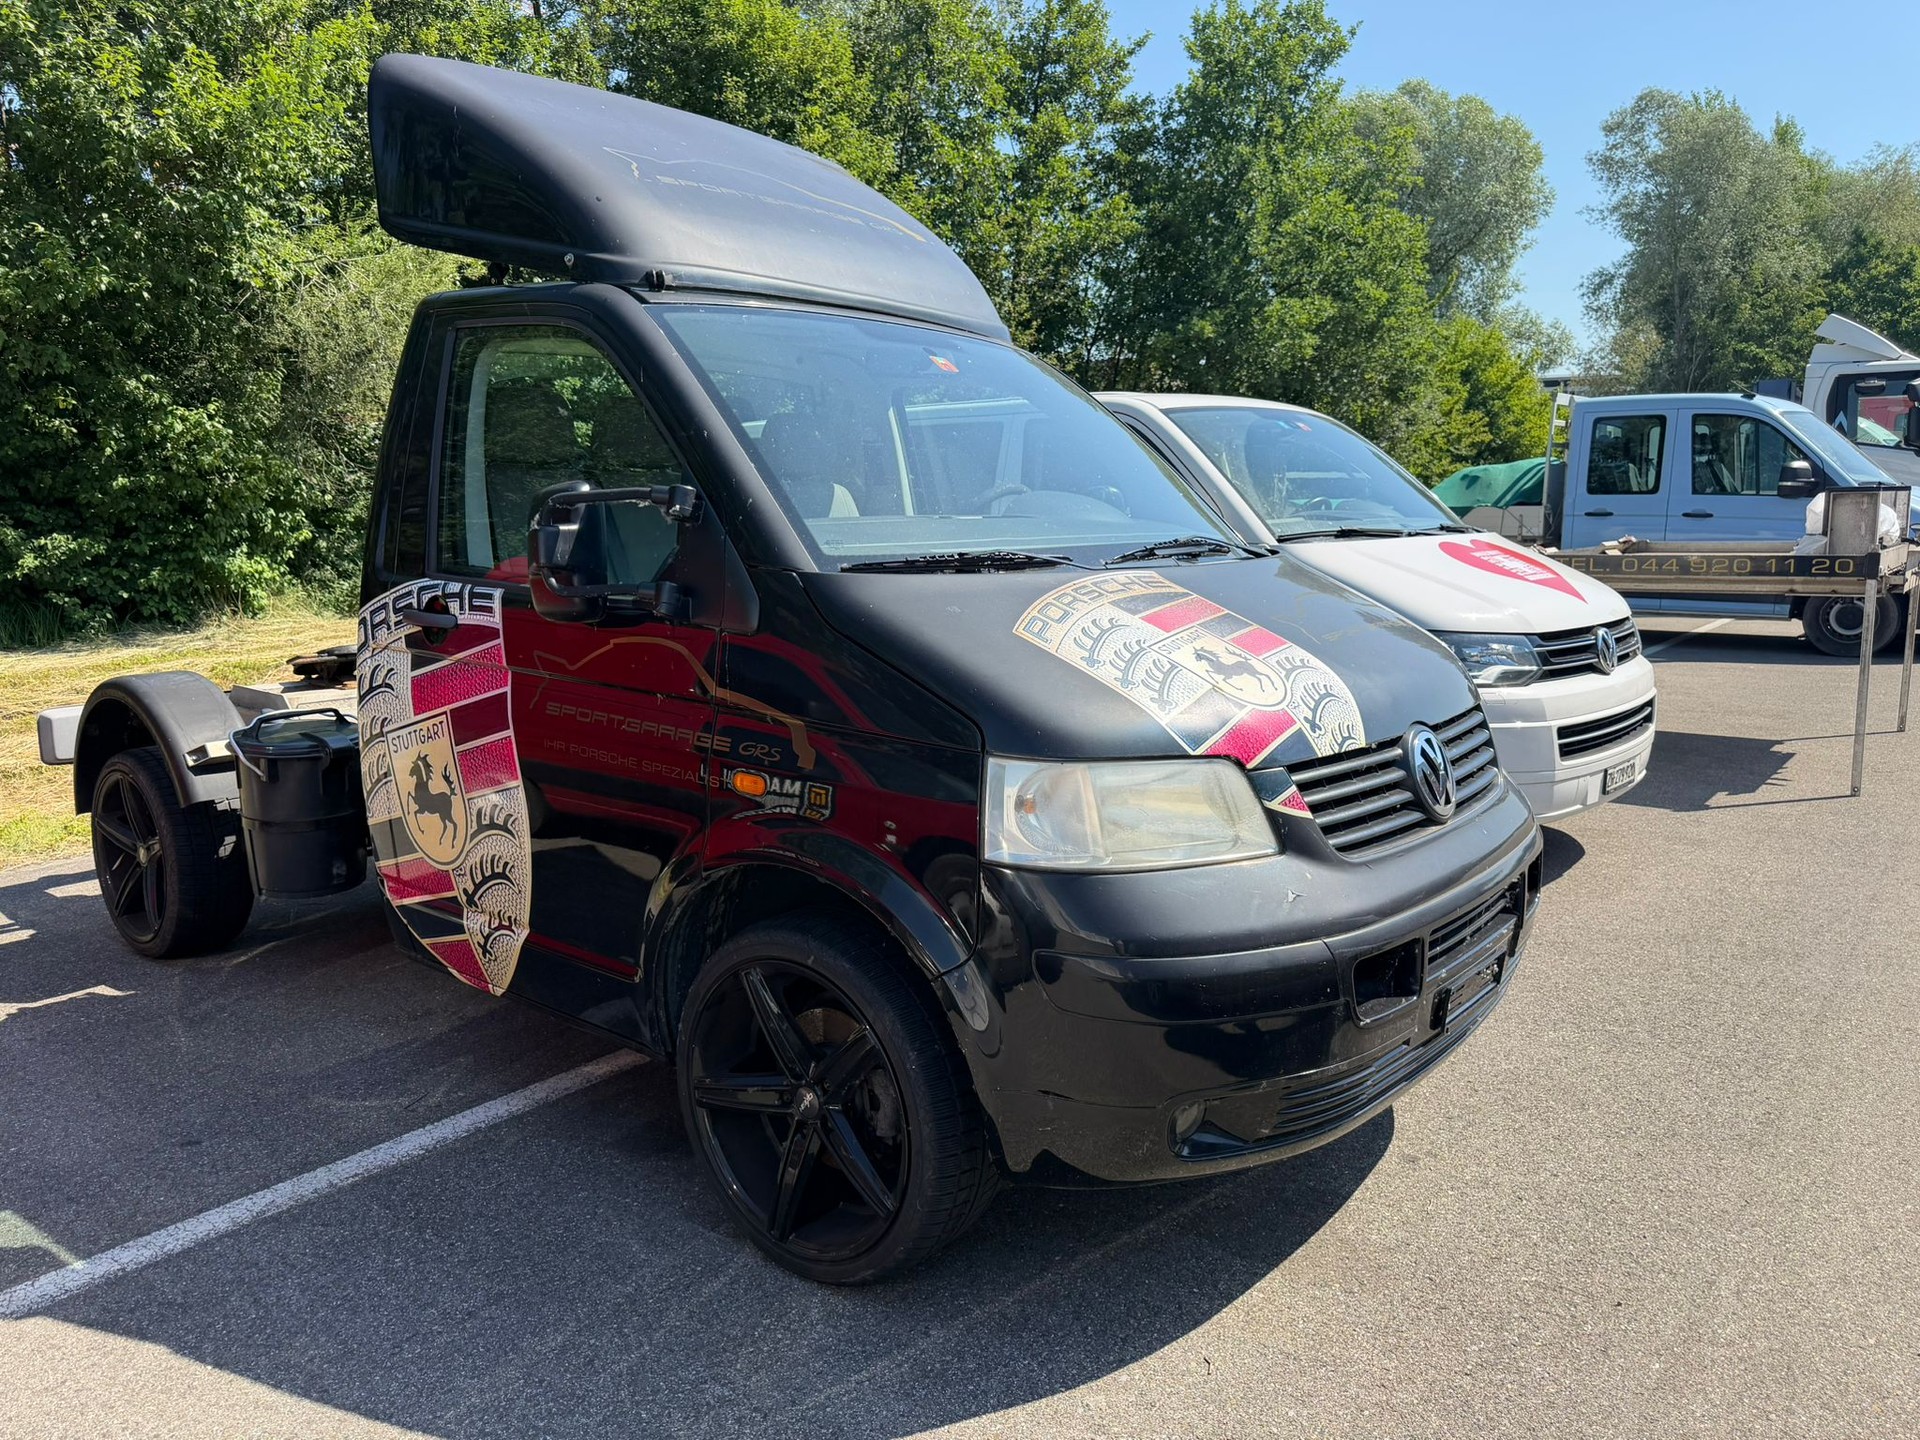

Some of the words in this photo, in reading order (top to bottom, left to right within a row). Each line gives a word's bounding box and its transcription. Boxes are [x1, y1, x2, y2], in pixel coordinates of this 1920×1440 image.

[1621, 557, 1680, 572] 044
[1690, 557, 1750, 574] 920
[1766, 558, 1796, 574] 11
[1811, 558, 1855, 575] 20
[358, 582, 496, 652] ORSCHE
[1022, 575, 1178, 644] PORSCHE
[1158, 629, 1208, 655] STUTTGART
[391, 719, 446, 754] STUTTGART
[545, 702, 732, 752] SPORTGARAGE
[739, 742, 781, 762] GRS
[543, 739, 566, 753] IHR
[570, 745, 638, 769] PORSCHE
